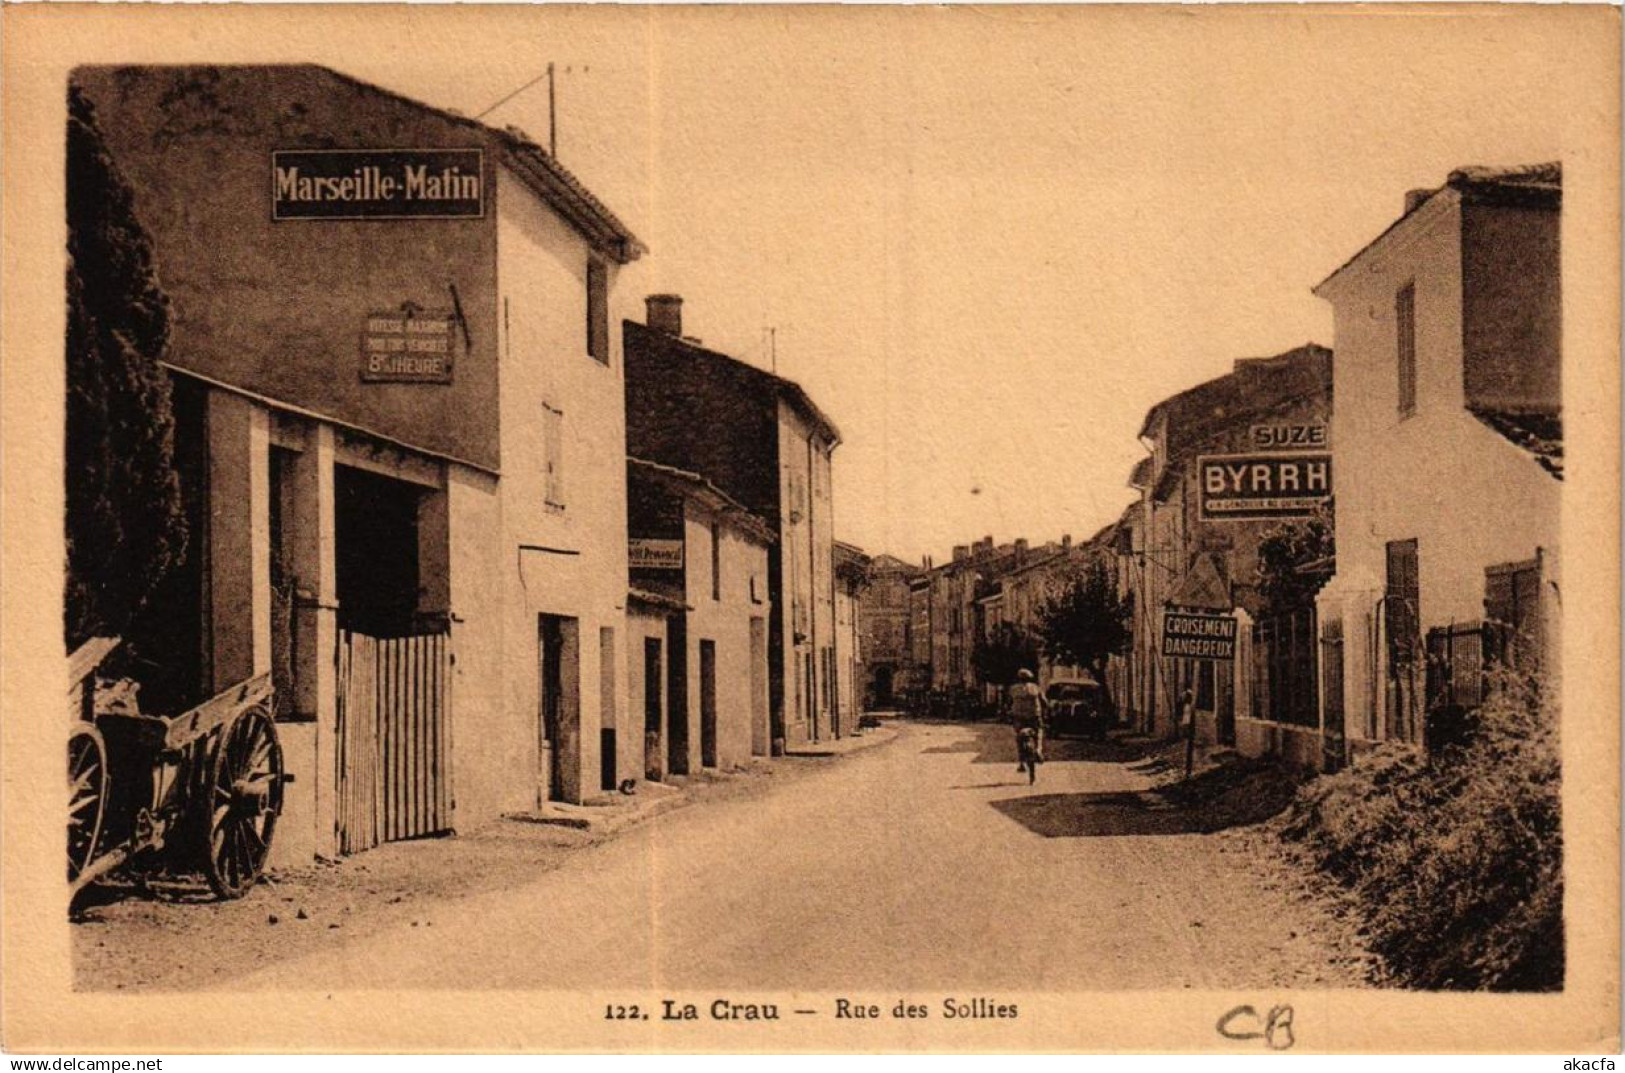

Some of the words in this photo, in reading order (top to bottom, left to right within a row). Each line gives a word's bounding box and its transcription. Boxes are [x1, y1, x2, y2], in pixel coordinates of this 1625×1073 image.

[275, 165, 479, 201] Marseille-Matin
[1254, 425, 1325, 447] SUZE
[1205, 463, 1327, 493] BYRRH
[1166, 617, 1235, 637] CROISEMENT
[1164, 637, 1233, 657] DANGEREUX
